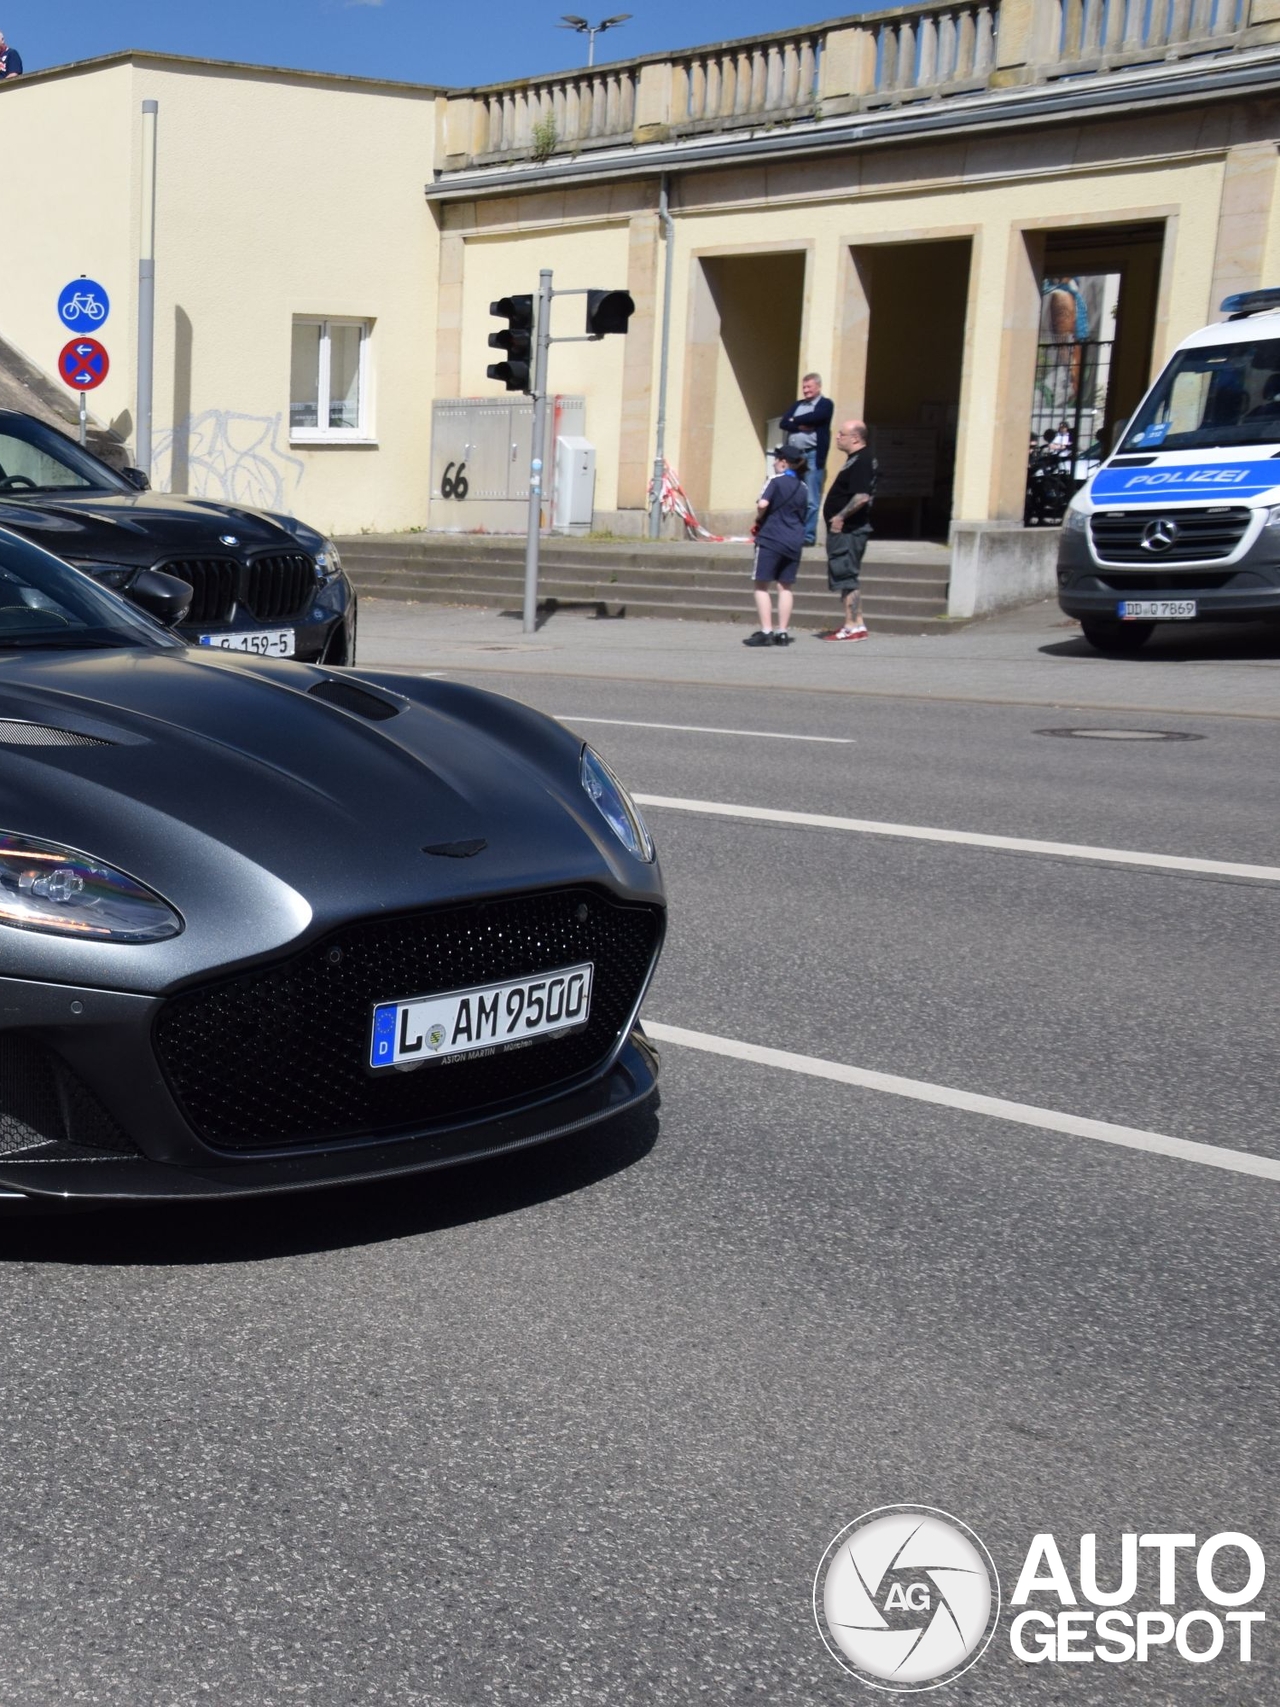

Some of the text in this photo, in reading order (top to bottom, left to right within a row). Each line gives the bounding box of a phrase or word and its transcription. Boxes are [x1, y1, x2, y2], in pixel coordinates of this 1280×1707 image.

[441, 462, 468, 499] 66
[1123, 470, 1252, 488] POLIZEI
[399, 973, 584, 1054] L AM 9500
[378, 1041, 389, 1056] D
[441, 1053, 467, 1065] ASTON
[468, 1047, 496, 1061] MARTIN
